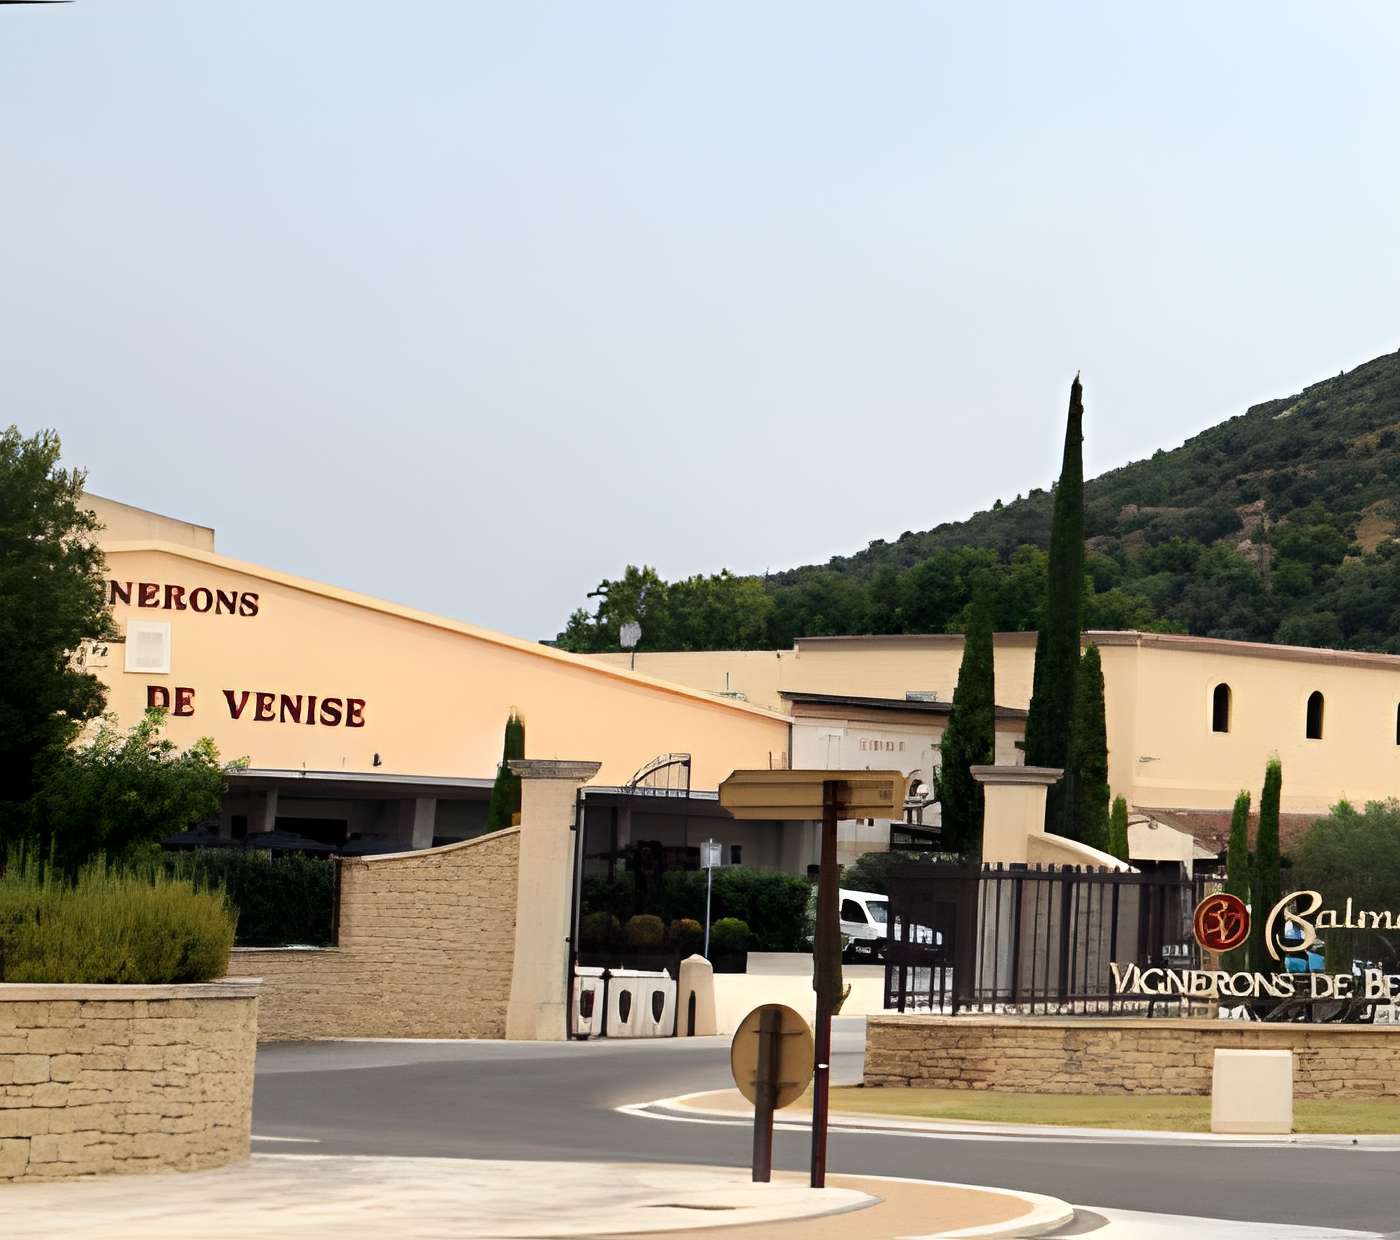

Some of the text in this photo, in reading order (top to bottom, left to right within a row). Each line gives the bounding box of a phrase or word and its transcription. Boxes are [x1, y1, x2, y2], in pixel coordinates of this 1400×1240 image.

[146, 685, 366, 728] DE VENISE
[1109, 961, 1295, 999] VIGNERONS
[1310, 972, 1353, 1000] DE
